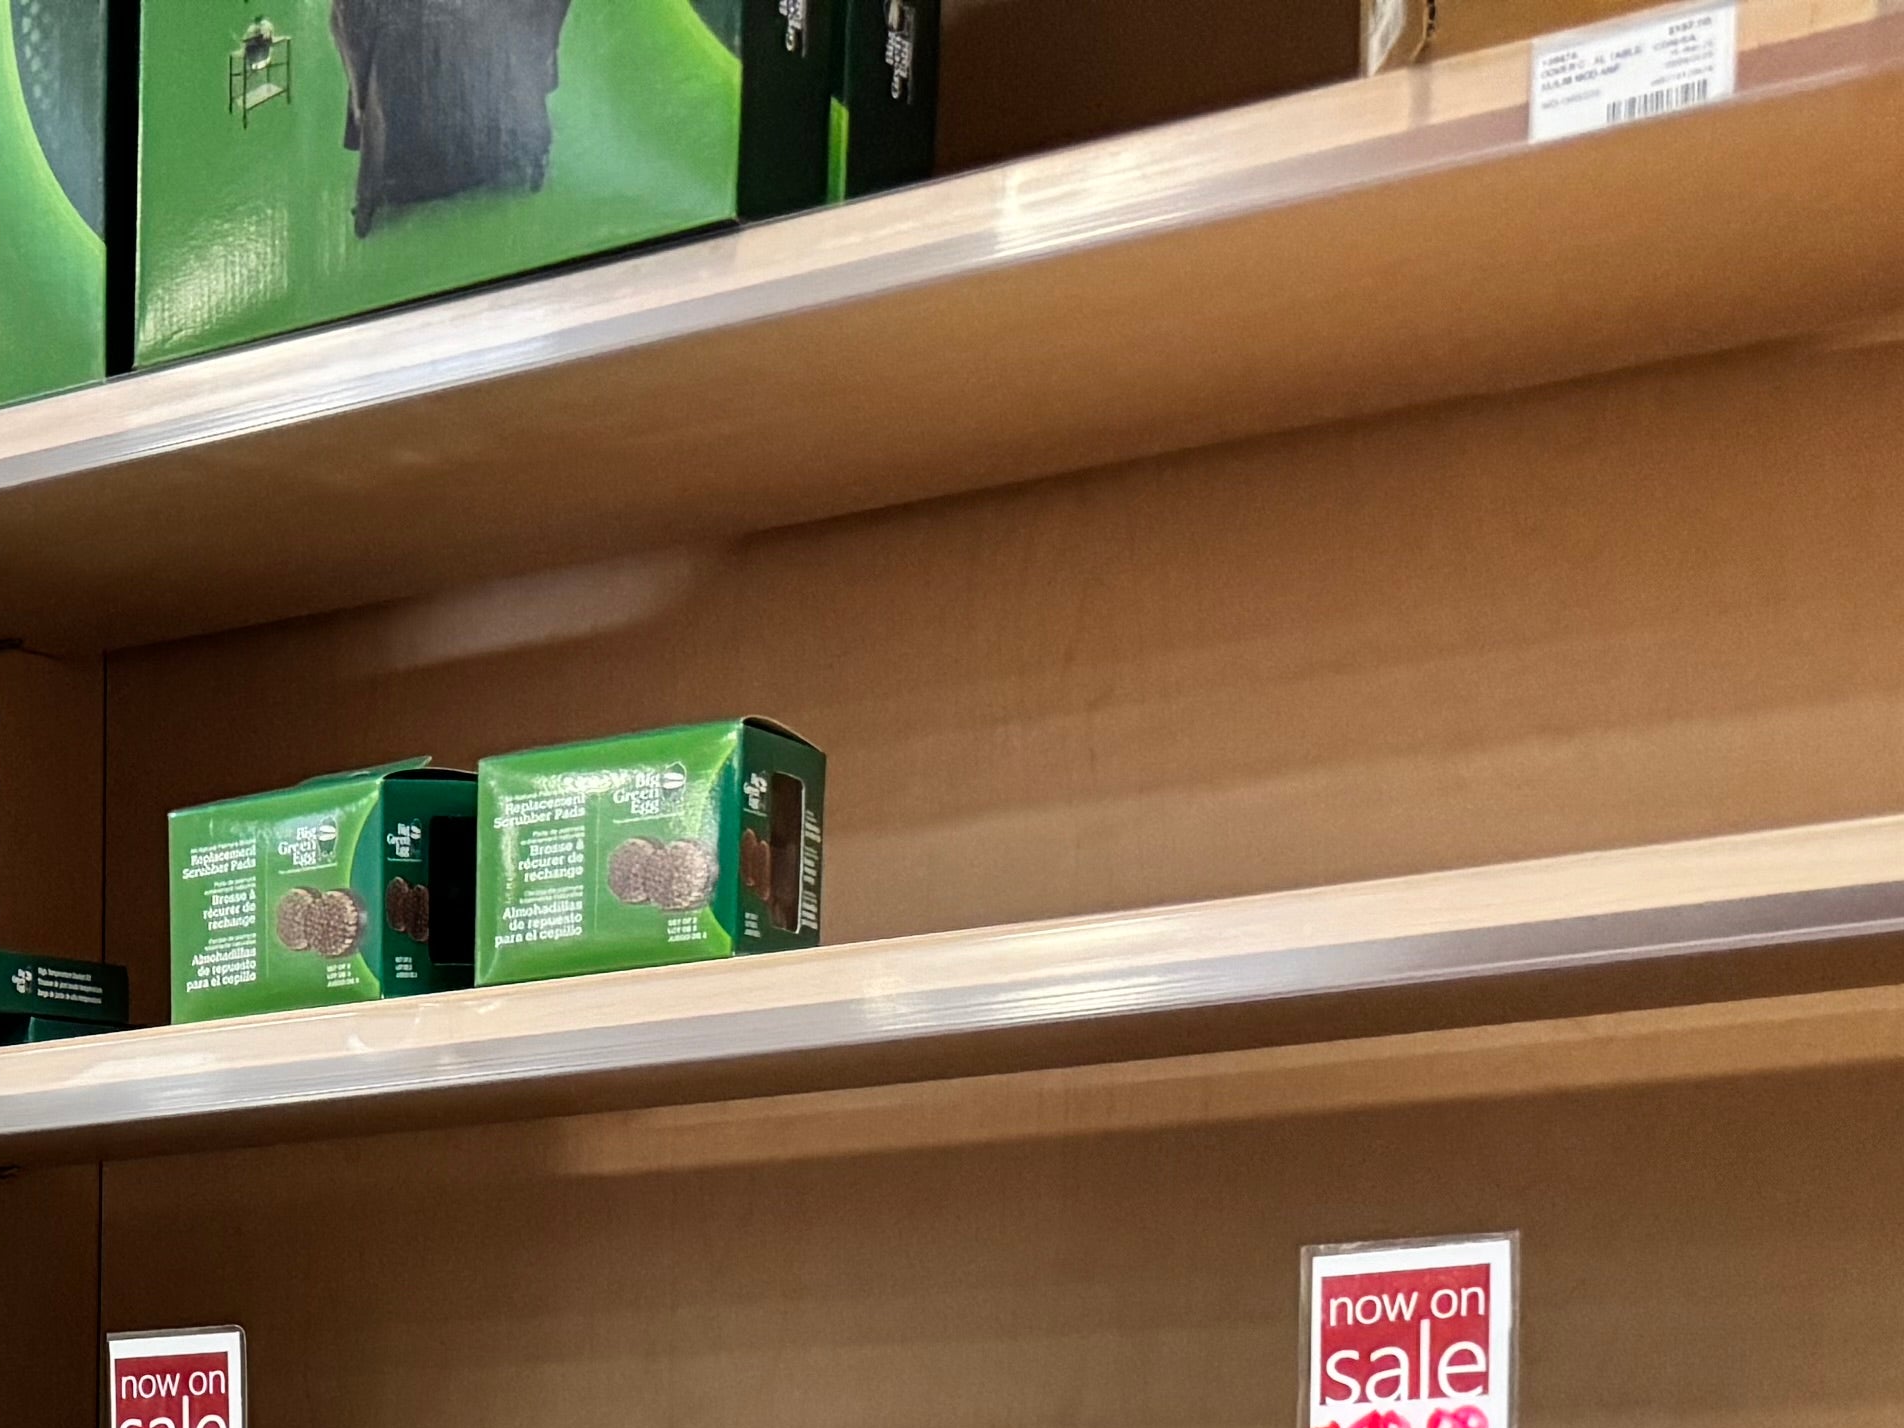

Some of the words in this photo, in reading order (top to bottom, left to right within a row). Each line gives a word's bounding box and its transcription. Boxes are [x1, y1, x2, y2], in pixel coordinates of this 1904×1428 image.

[1329, 1291, 1418, 1327] now
[1431, 1286, 1485, 1320] on
[1325, 1319, 1488, 1405] sale
[121, 1373, 180, 1399] now
[189, 1370, 225, 1396] on
